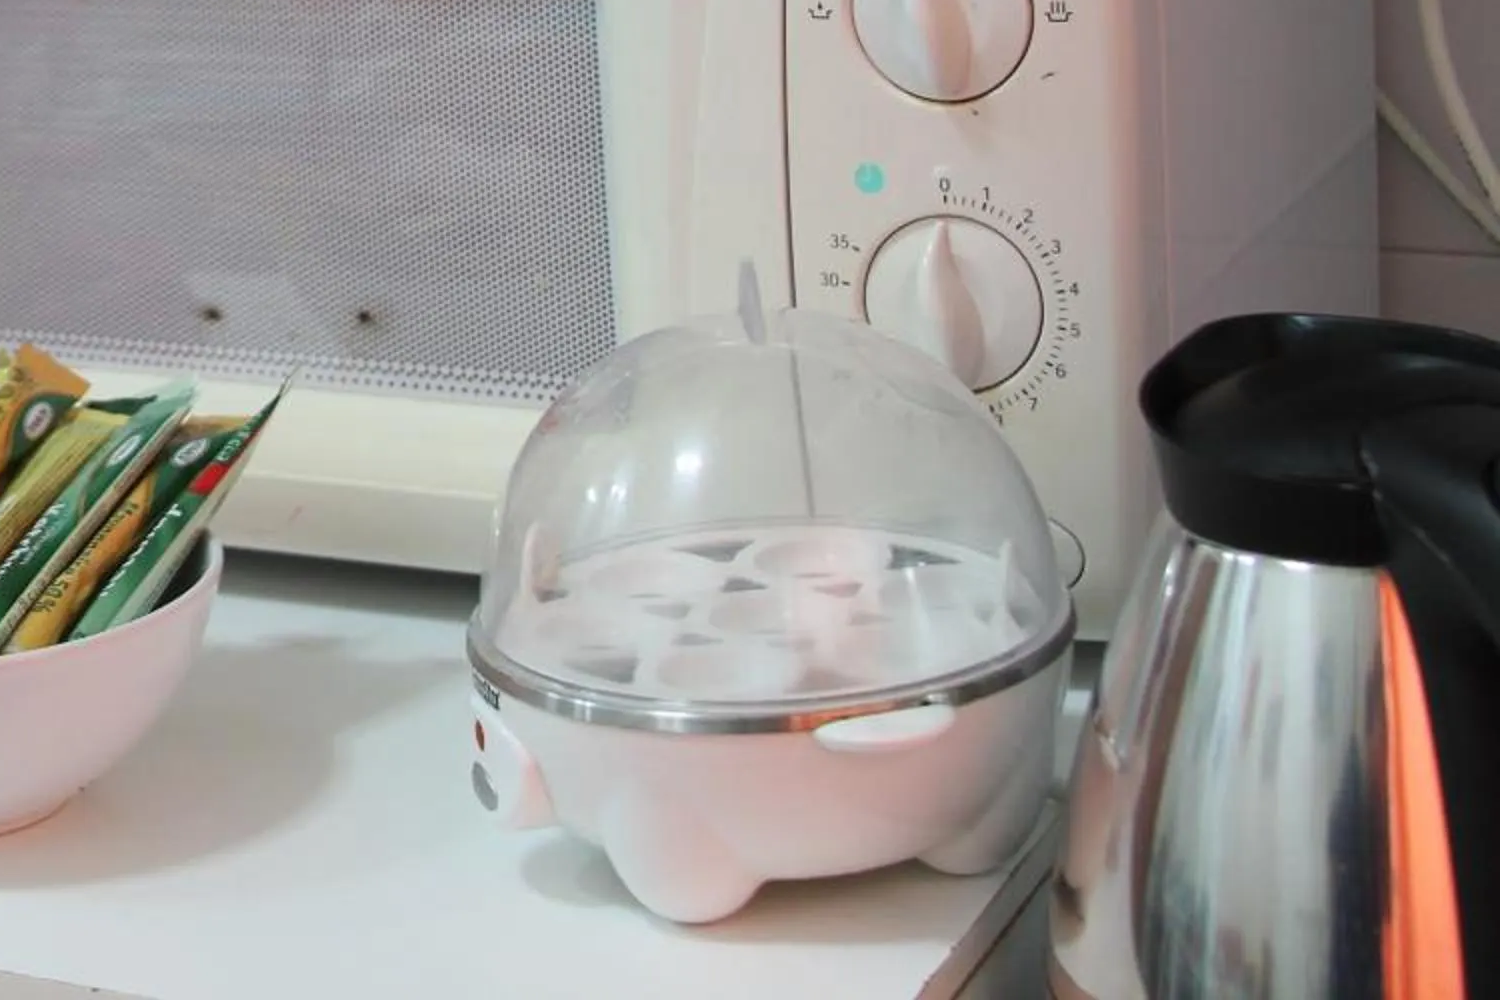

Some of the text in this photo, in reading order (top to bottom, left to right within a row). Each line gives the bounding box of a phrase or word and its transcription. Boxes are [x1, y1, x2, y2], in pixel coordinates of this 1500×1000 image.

[939, 177, 951, 193] 0
[982, 186, 990, 200] 1
[1022, 208, 1035, 224] 2
[830, 233, 850, 250] 35
[1050, 239, 1061, 255] 3
[820, 272, 839, 288] 30
[1069, 282, 1080, 297] 4
[1070, 322, 1081, 338] 5
[1054, 363, 1067, 379] 6
[1028, 397, 1038, 412] 7
